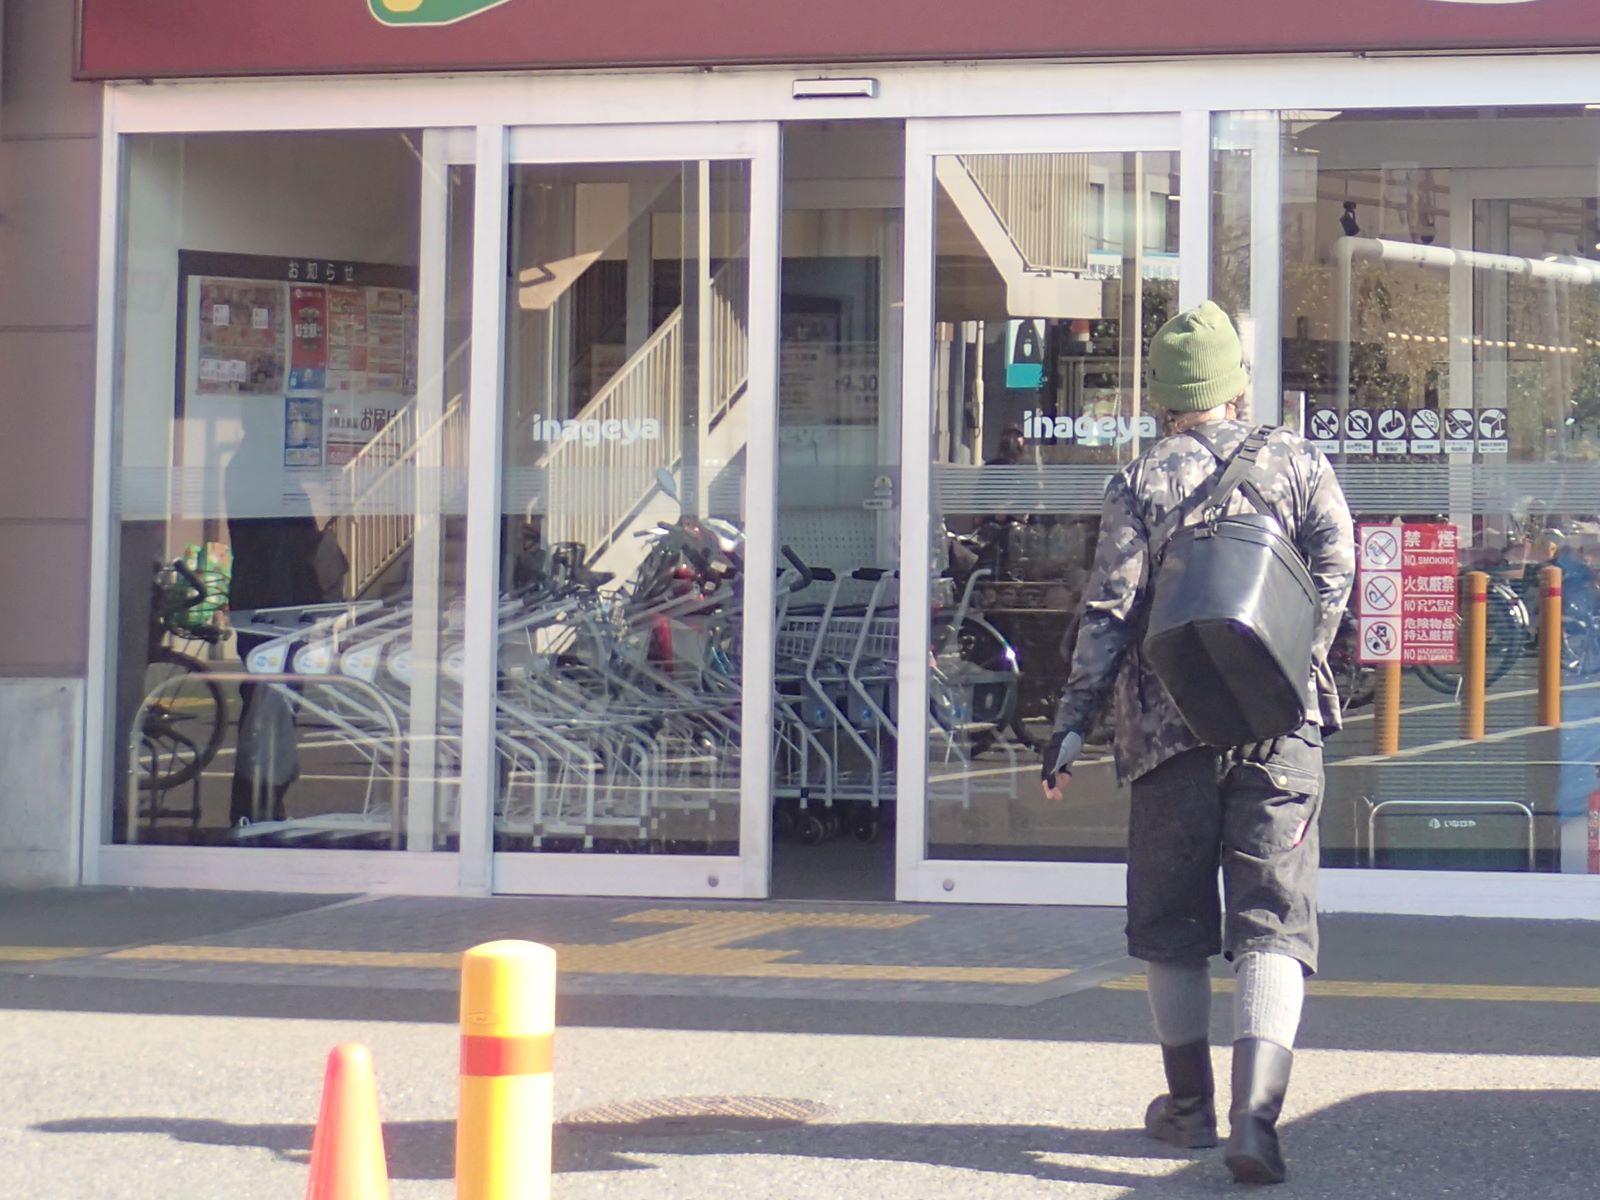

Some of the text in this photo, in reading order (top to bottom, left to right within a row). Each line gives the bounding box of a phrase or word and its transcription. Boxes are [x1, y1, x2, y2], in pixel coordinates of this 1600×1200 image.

[288, 260, 355, 282] お知らせ
[533, 414, 660, 448] inageya
[1023, 410, 1157, 446] inageya
[1404, 530, 1456, 548] 禁煙
[1404, 555, 1454, 566] NO SMOKING
[1404, 576, 1454, 592] 火気厳禁
[1404, 600, 1416, 612] NO
[1404, 649, 1416, 660] NO
